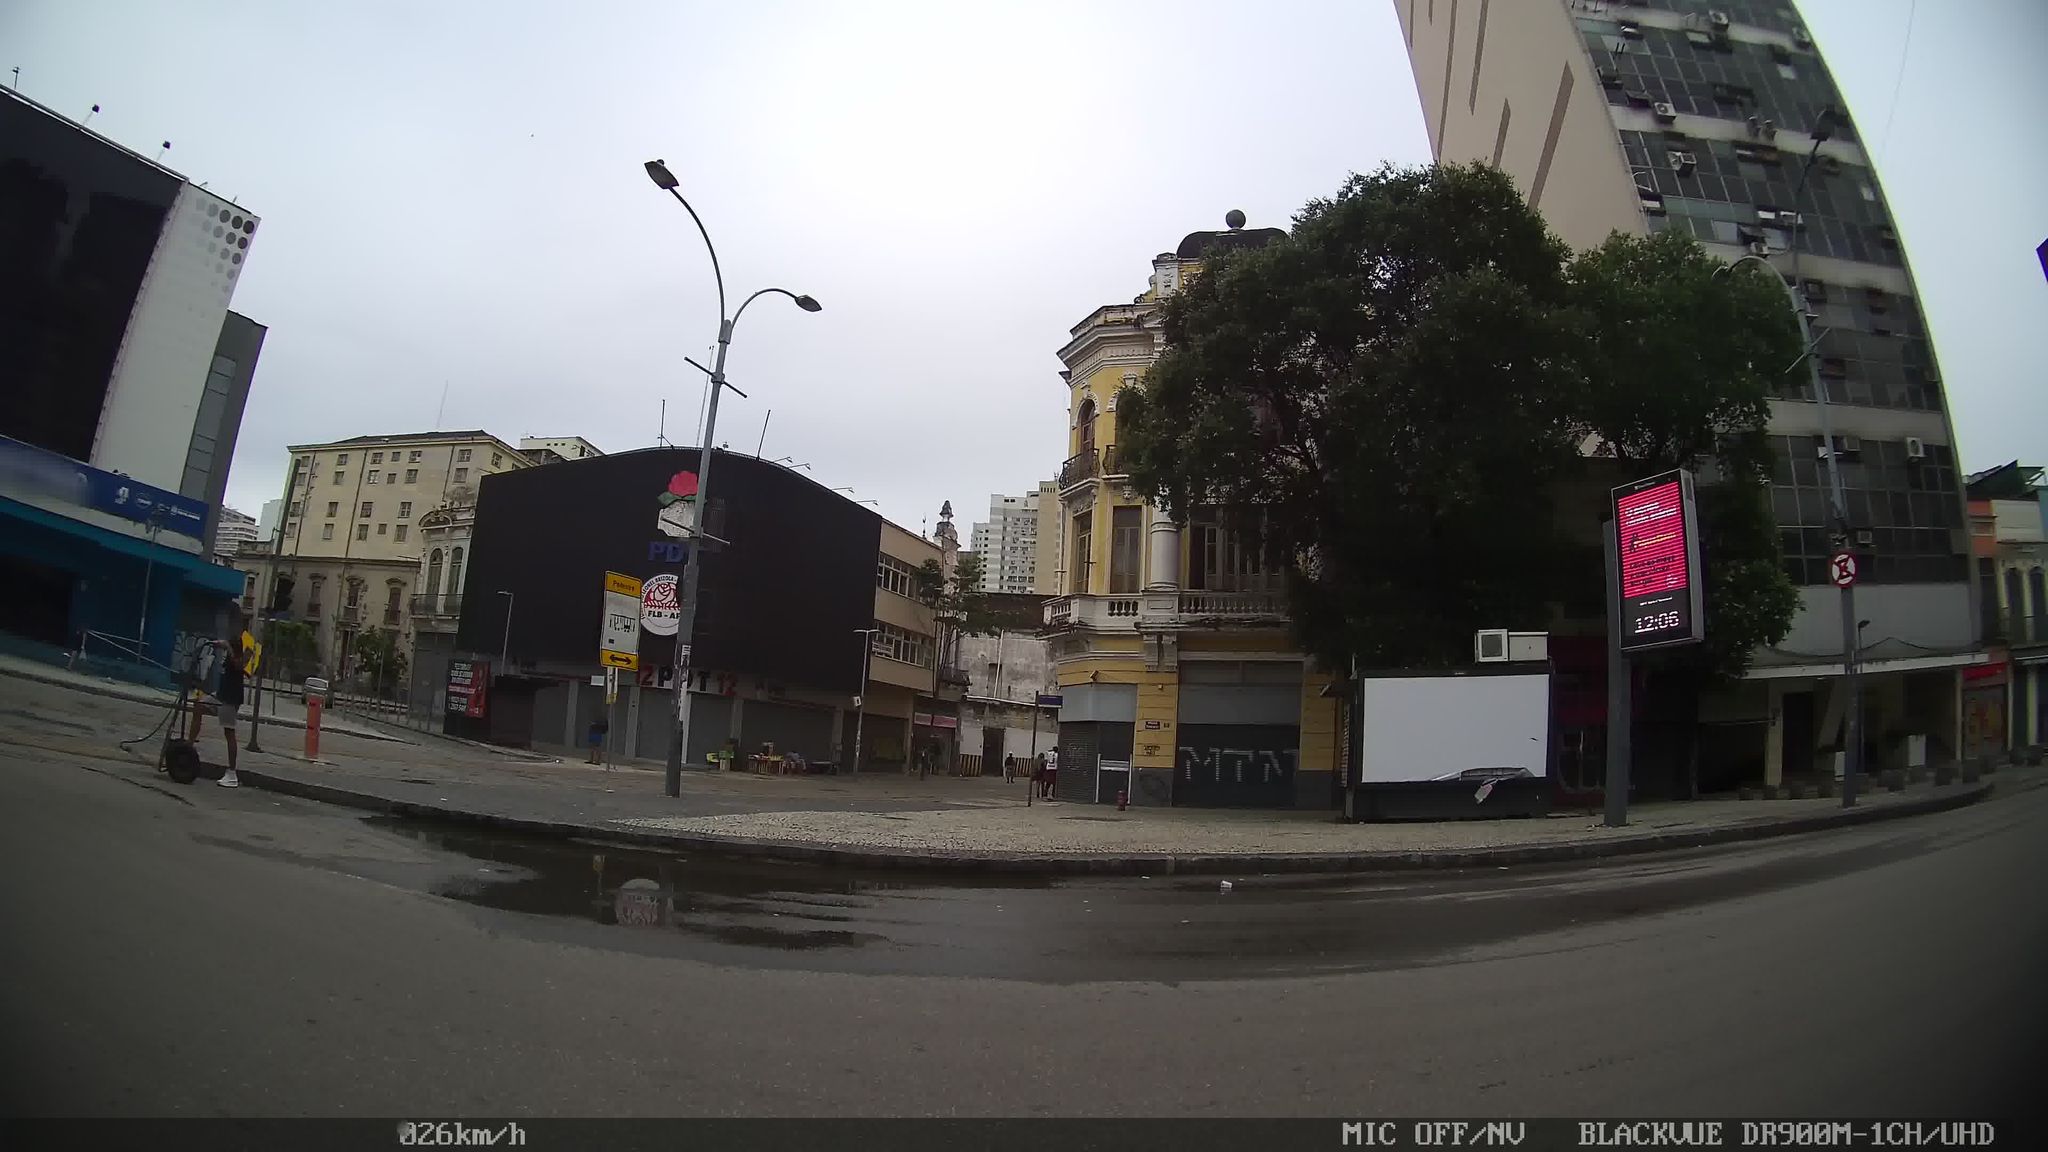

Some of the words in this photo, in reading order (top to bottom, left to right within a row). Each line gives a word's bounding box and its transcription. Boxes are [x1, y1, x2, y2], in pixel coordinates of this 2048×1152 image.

[648, 541, 685, 563] PD
[655, 575, 673, 583] BRIZOLA
[648, 610, 662, 618] FLB
[1634, 610, 1680, 634] 12:06
